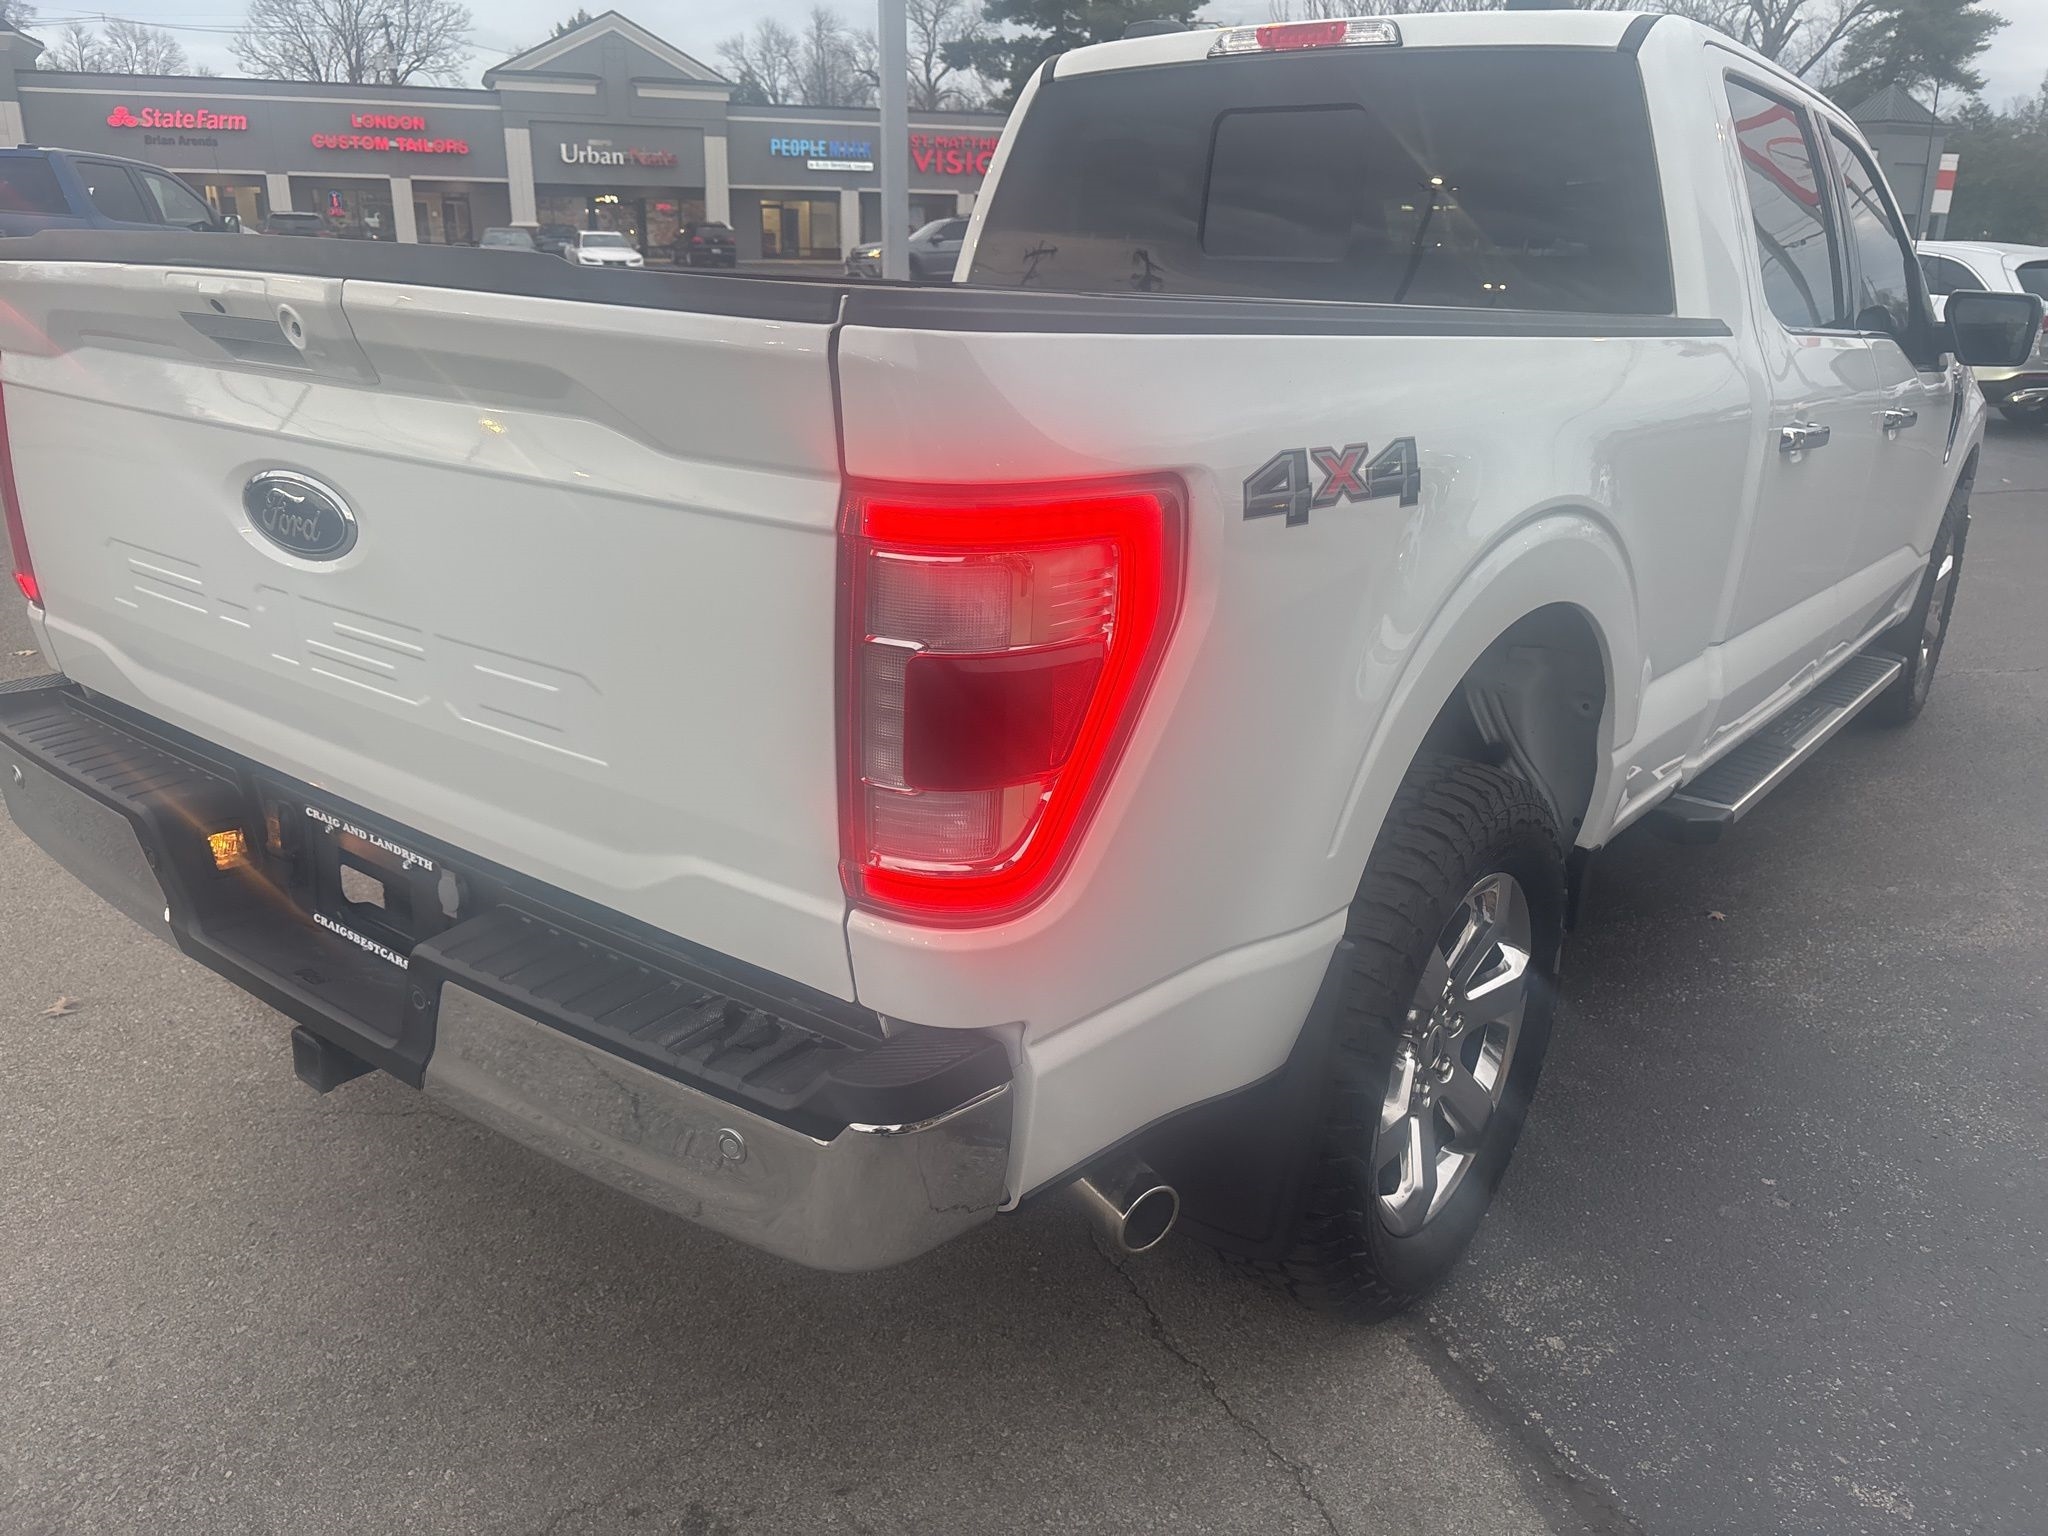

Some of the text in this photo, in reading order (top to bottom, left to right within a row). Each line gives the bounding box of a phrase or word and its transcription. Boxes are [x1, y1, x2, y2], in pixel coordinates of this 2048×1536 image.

[351, 113, 425, 130] LONDON
[311, 133, 469, 154] CUSTOM TAILORS
[559, 142, 625, 166] Urban
[770, 138, 827, 157] PEOPLE
[262, 487, 321, 542] Ford
[305, 807, 433, 872] CRAIG AND LANDRETH
